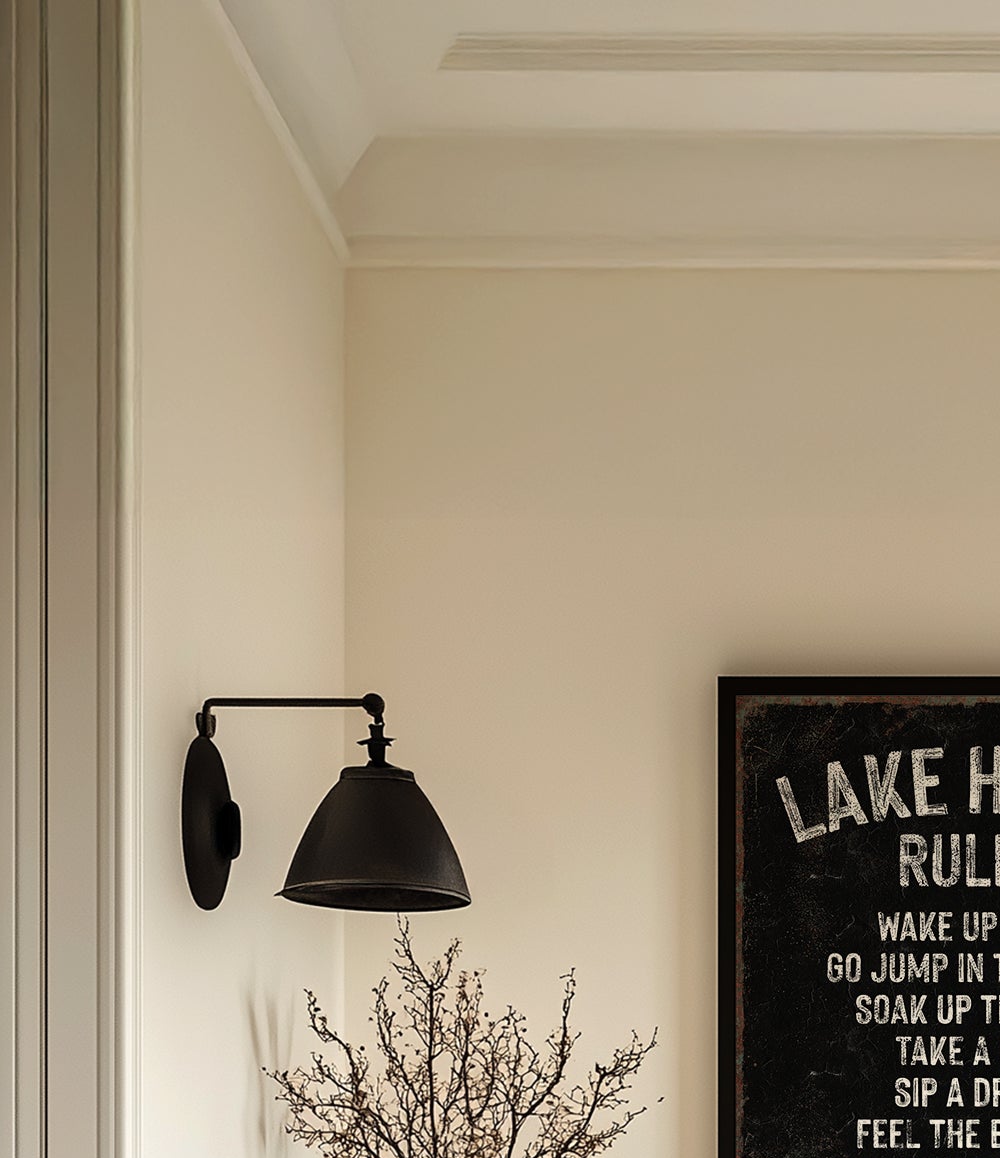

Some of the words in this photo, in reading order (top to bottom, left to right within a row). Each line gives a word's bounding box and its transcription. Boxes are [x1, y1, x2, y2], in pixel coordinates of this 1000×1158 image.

[775, 747, 948, 843] LAKE
[878, 911, 953, 942] WAKE
[963, 911, 998, 942] UP
[826, 952, 862, 983] GO
[870, 952, 949, 983] JUMP
[958, 952, 984, 983] IN
[855, 994, 928, 1025] SOAK
[937, 994, 972, 1025] UP
[895, 1035, 964, 1066] TAKE
[972, 1035, 991, 1066] A
[894, 1077, 938, 1108] SIP
[946, 1077, 965, 1108] A
[856, 1118, 921, 1149] FEEL
[929, 1118, 981, 1149] THE
